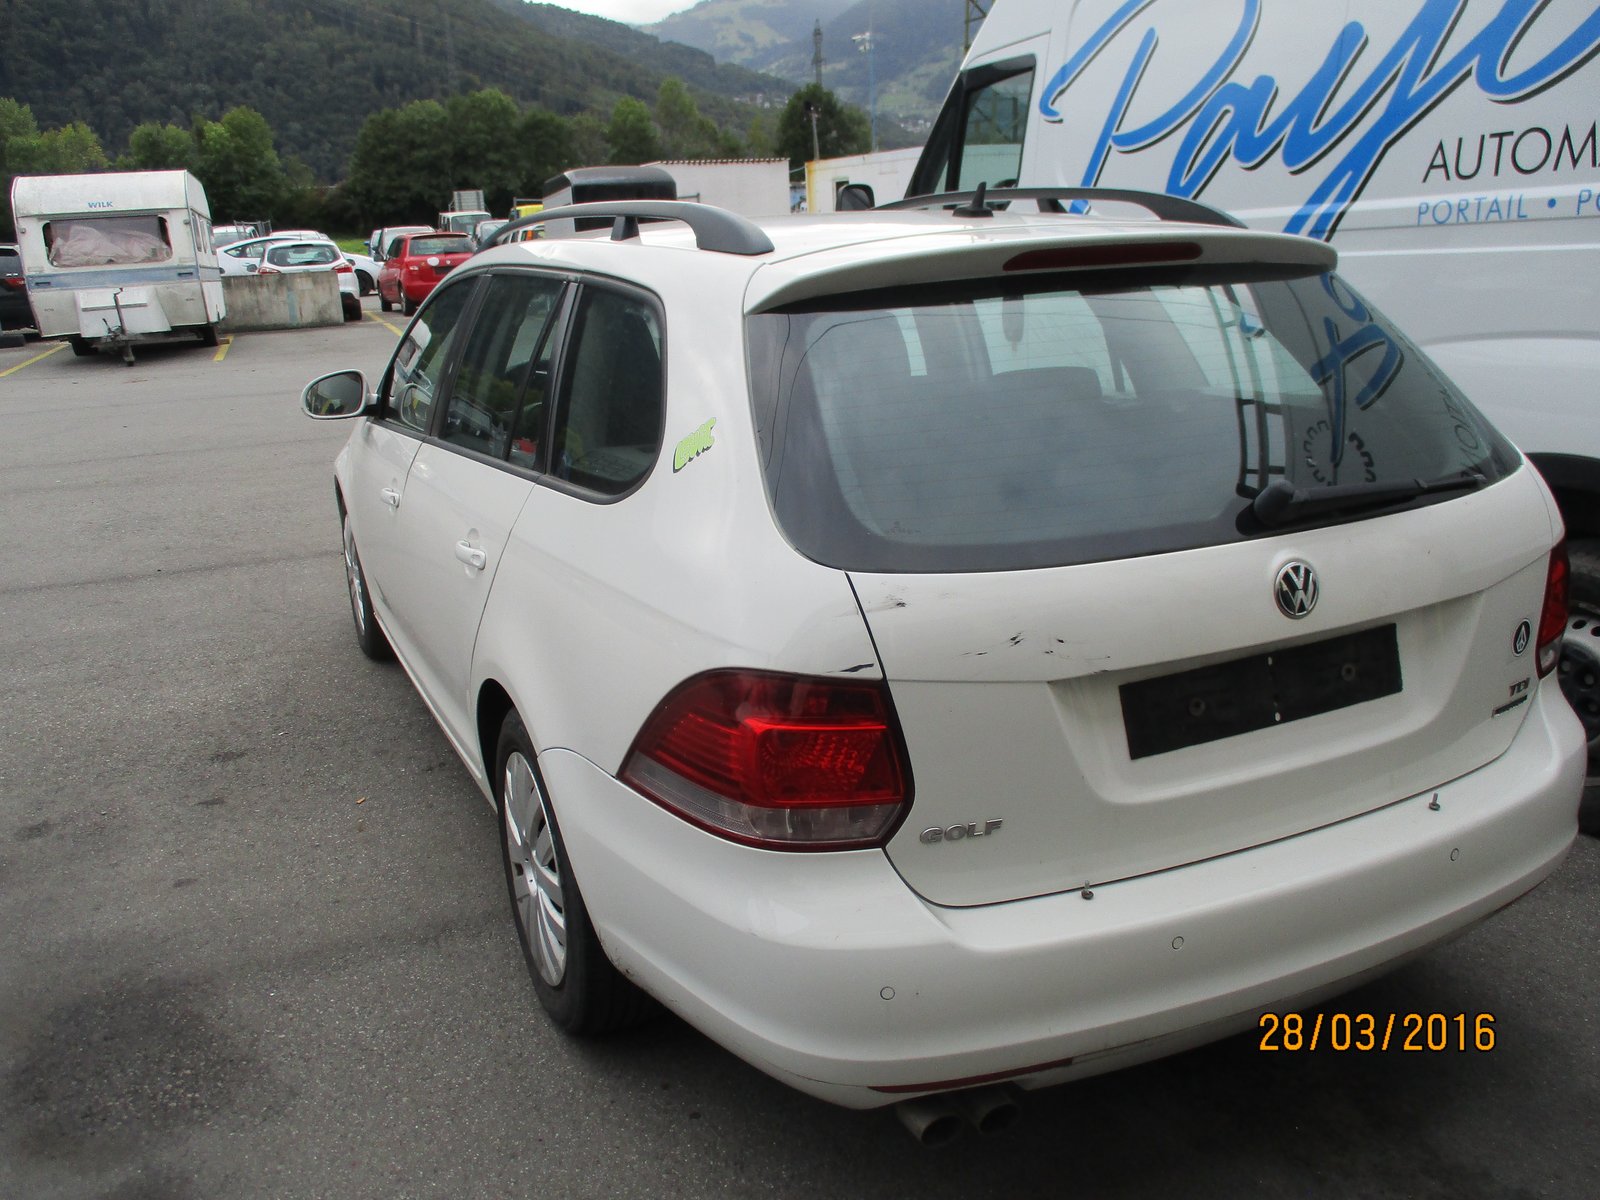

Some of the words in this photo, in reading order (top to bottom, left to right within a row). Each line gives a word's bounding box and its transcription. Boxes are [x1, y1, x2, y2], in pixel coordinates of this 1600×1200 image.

[1422, 119, 1600, 184] AUTOM
[87, 200, 114, 209] WILK
[1416, 193, 1529, 226] PORTAIL
[1576, 189, 1600, 216] P
[919, 817, 1003, 844] GOLF
